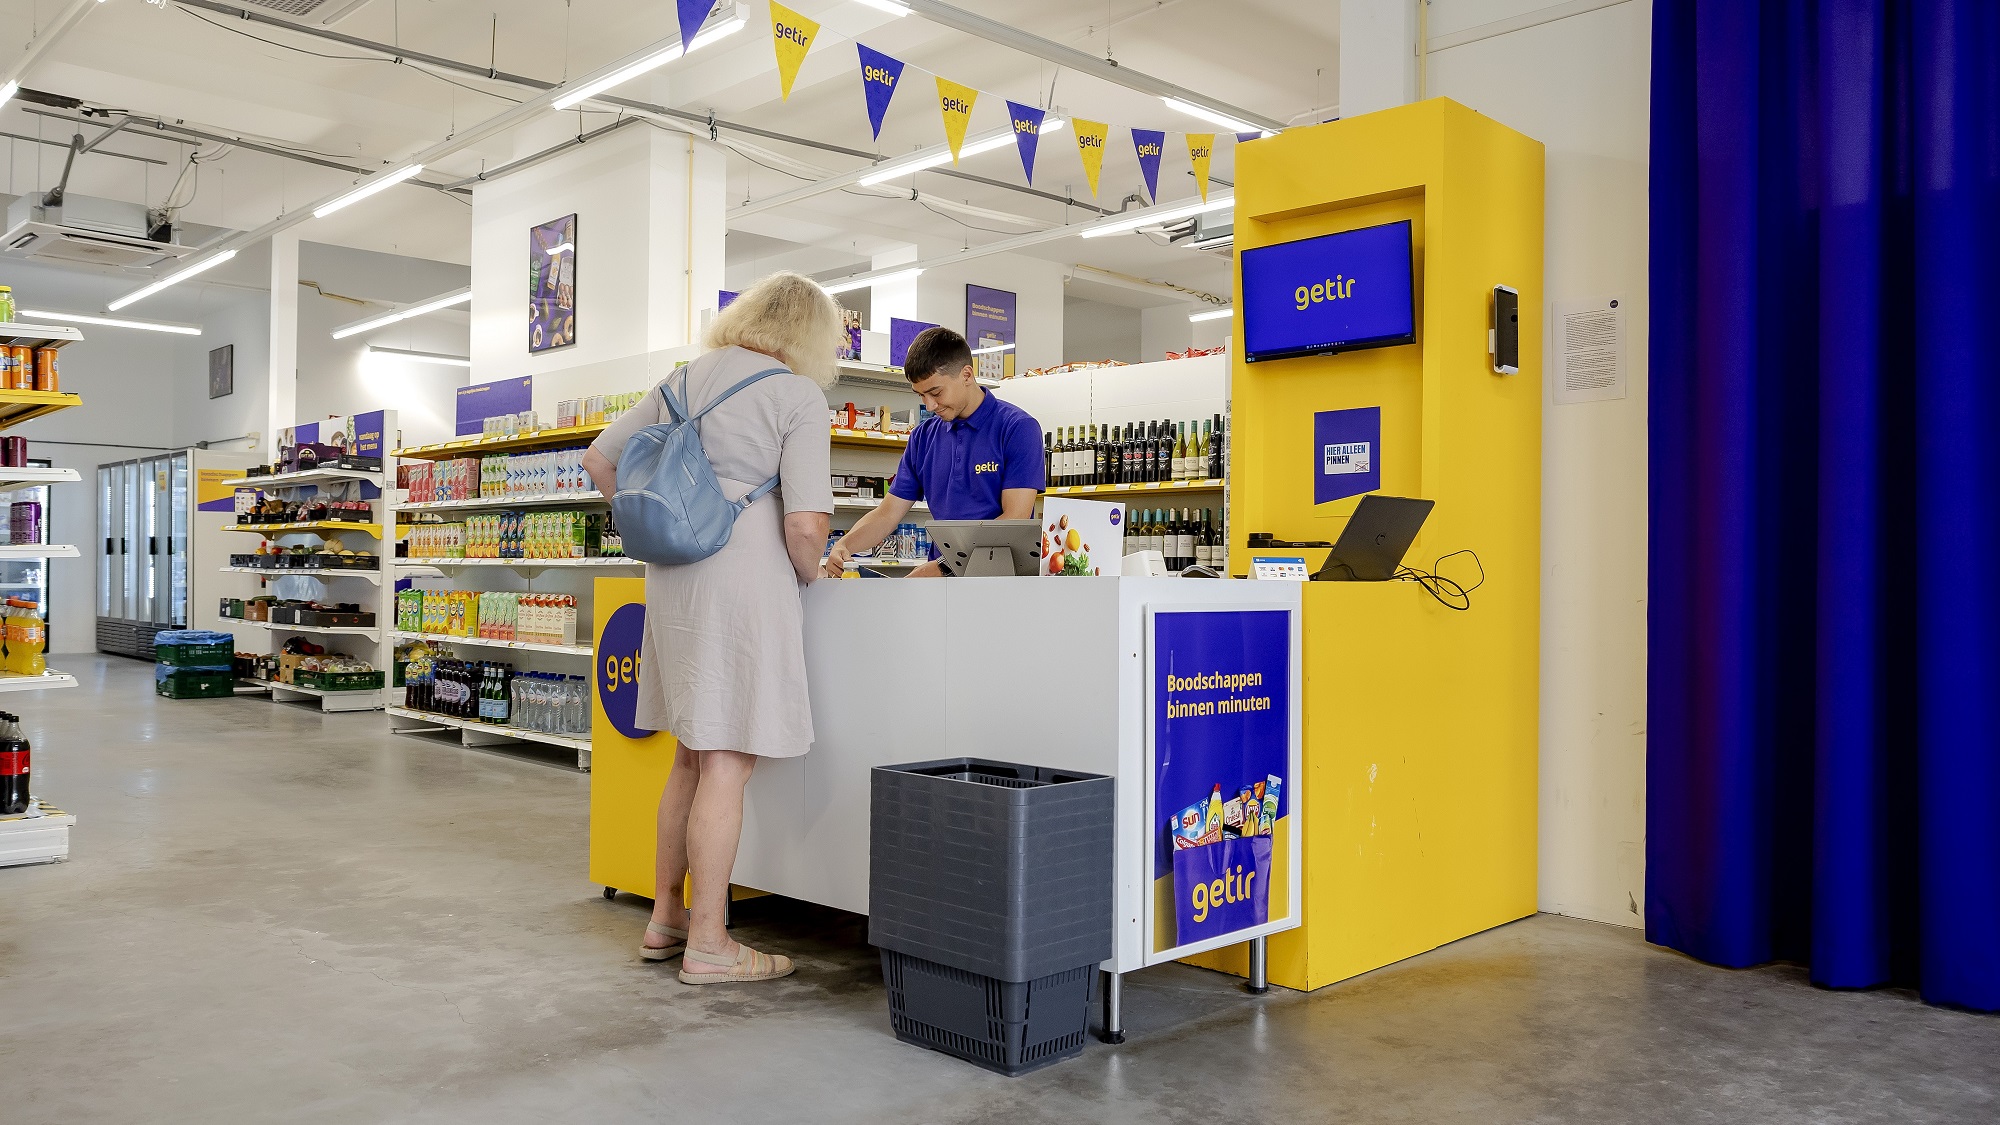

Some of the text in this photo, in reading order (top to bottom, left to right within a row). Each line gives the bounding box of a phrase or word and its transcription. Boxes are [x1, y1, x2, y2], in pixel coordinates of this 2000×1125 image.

[775, 22, 808, 47] getir
[865, 65, 895, 87] getir
[942, 96, 969, 115] getir
[1014, 119, 1038, 135] getir
[1079, 134, 1103, 149] getir
[1138, 142, 1161, 158] getir
[1191, 145, 1210, 161] getir
[1295, 274, 1356, 311] getir
[971, 302, 1005, 314] Boodschappen
[1326, 444, 1366, 456] HIER ALLEEN
[974, 461, 999, 475] getir
[1326, 455, 1350, 465] PINNEN
[1167, 670, 1263, 693] Boodschappen
[1167, 695, 1271, 719] binnen minuten
[1192, 864, 1256, 923] getir
